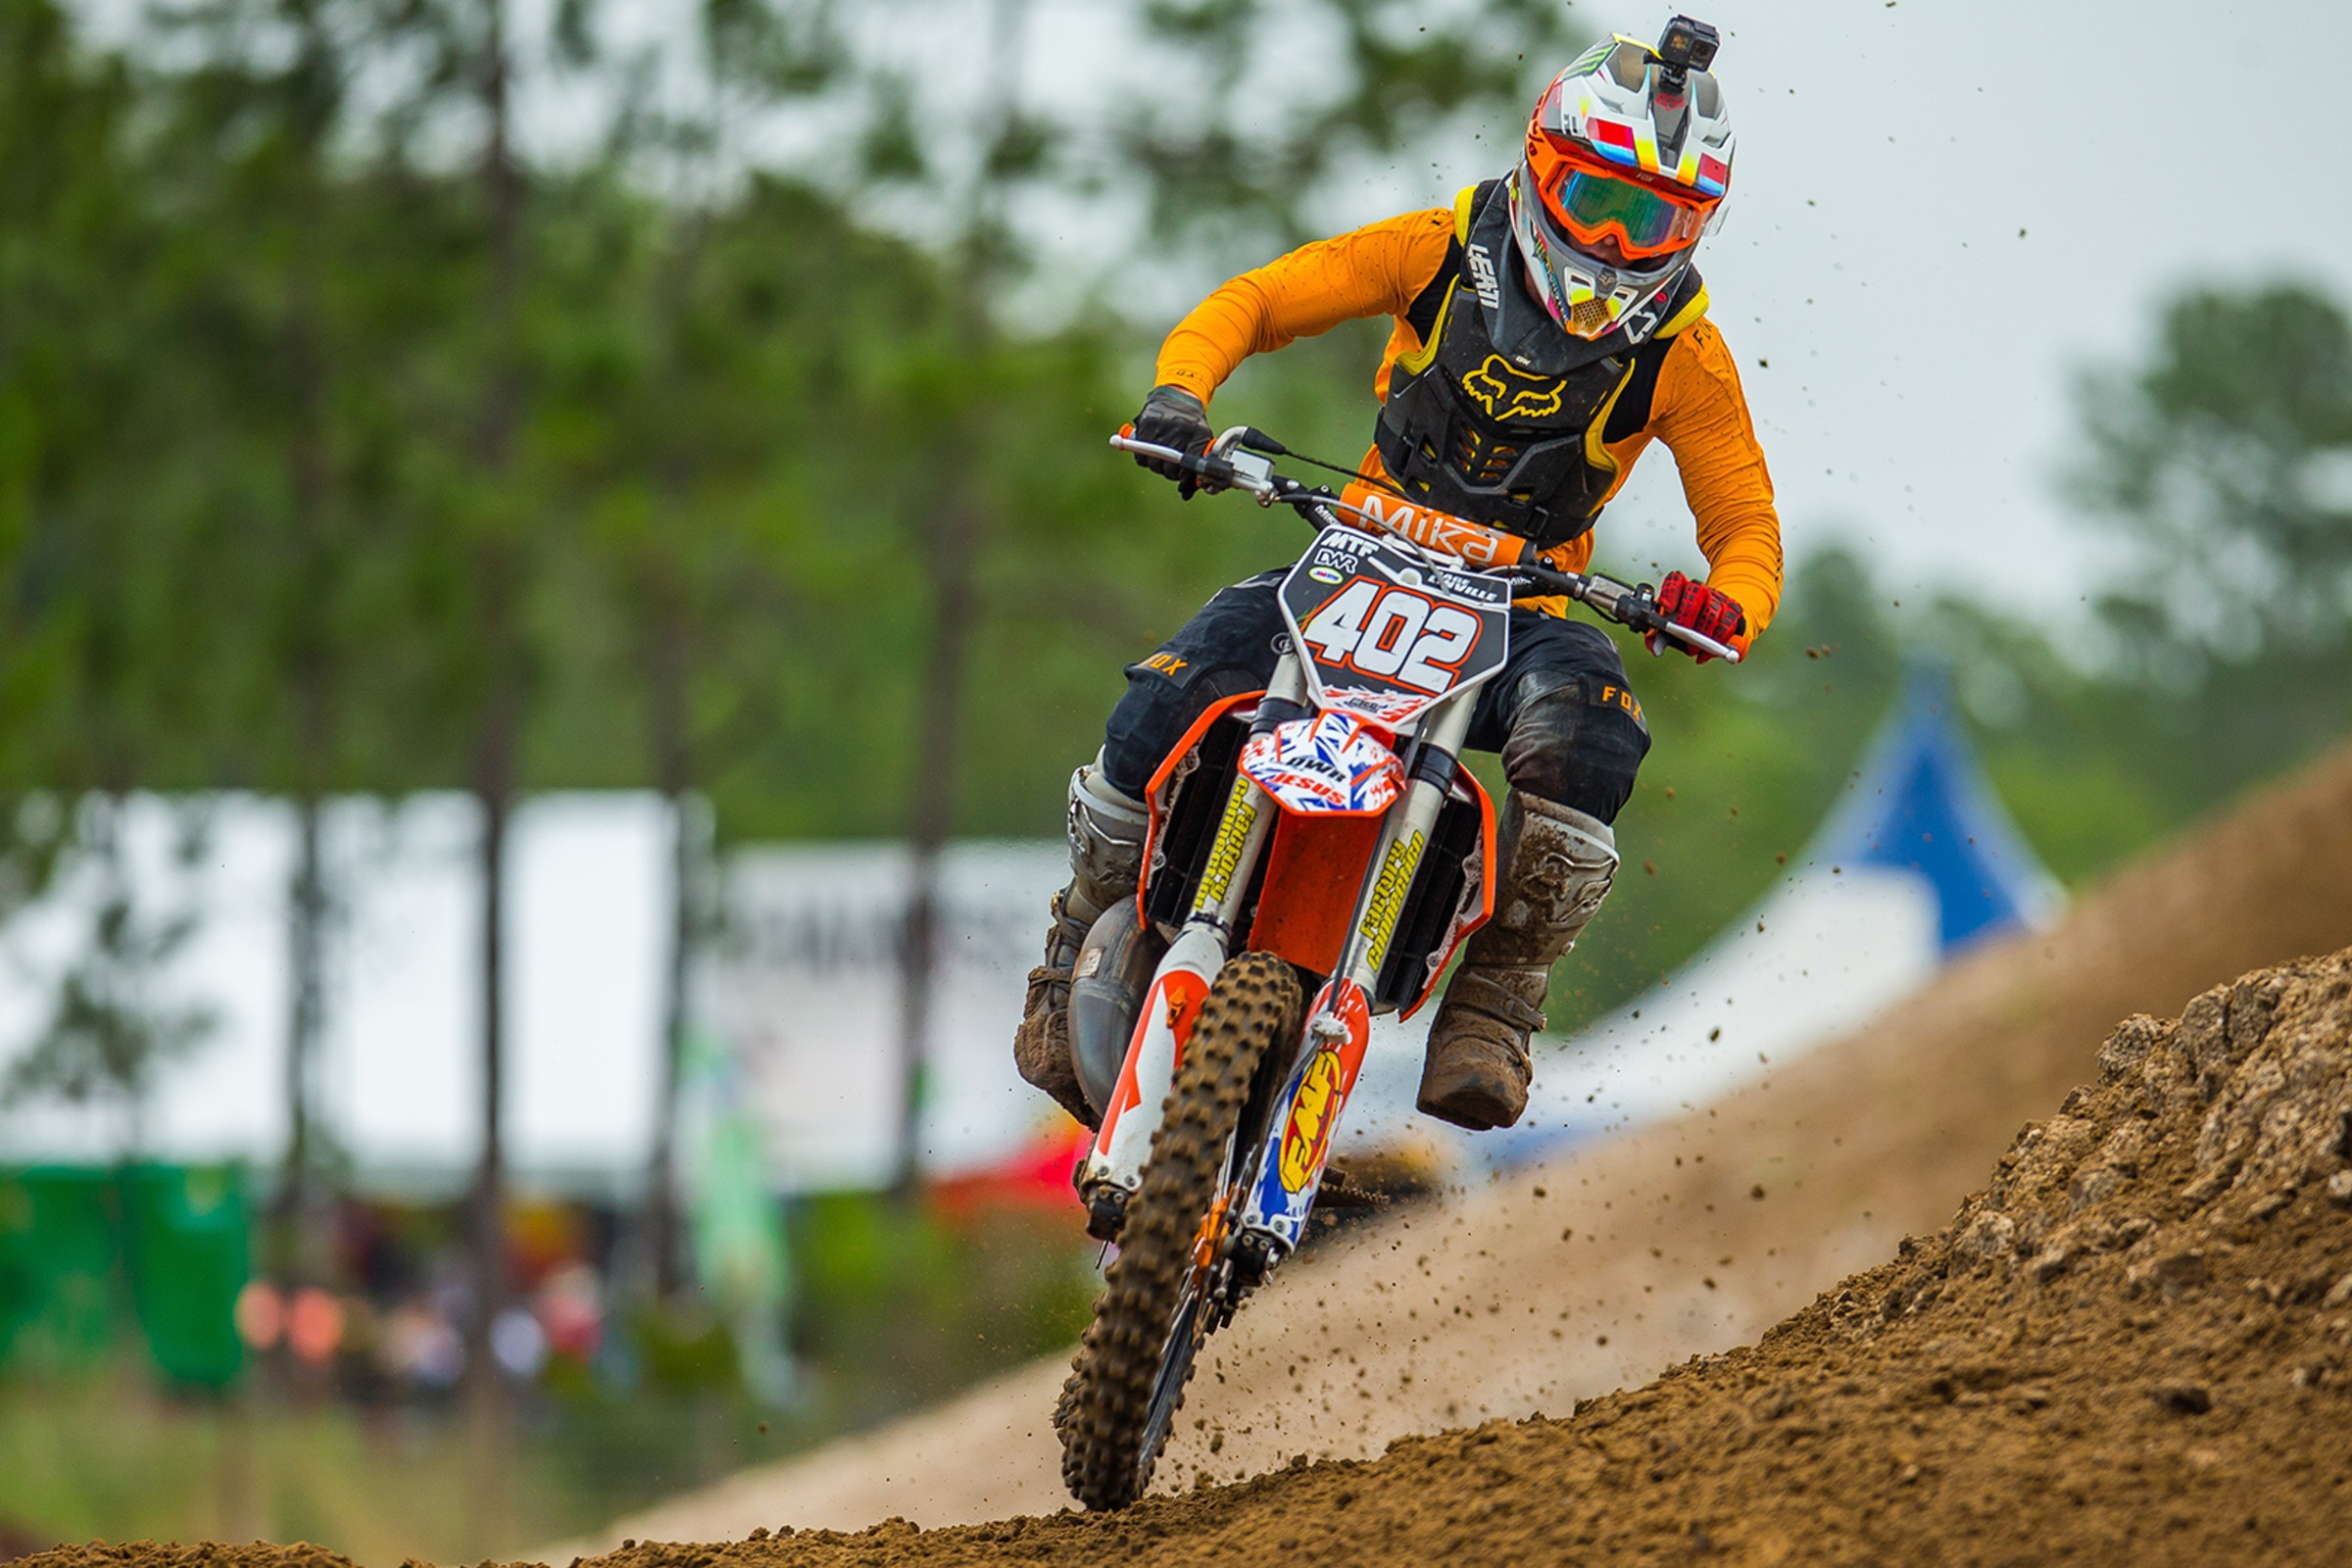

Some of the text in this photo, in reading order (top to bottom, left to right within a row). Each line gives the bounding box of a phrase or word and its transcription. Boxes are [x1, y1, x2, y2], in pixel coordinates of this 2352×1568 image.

[1320, 530, 1380, 558] MTF
[1313, 547, 1358, 574] DWR
[1302, 577, 1482, 697] 402
[1138, 654, 1189, 677] FOX
[1601, 685, 1642, 721] FOX
[1269, 771, 1348, 805] JESUS
